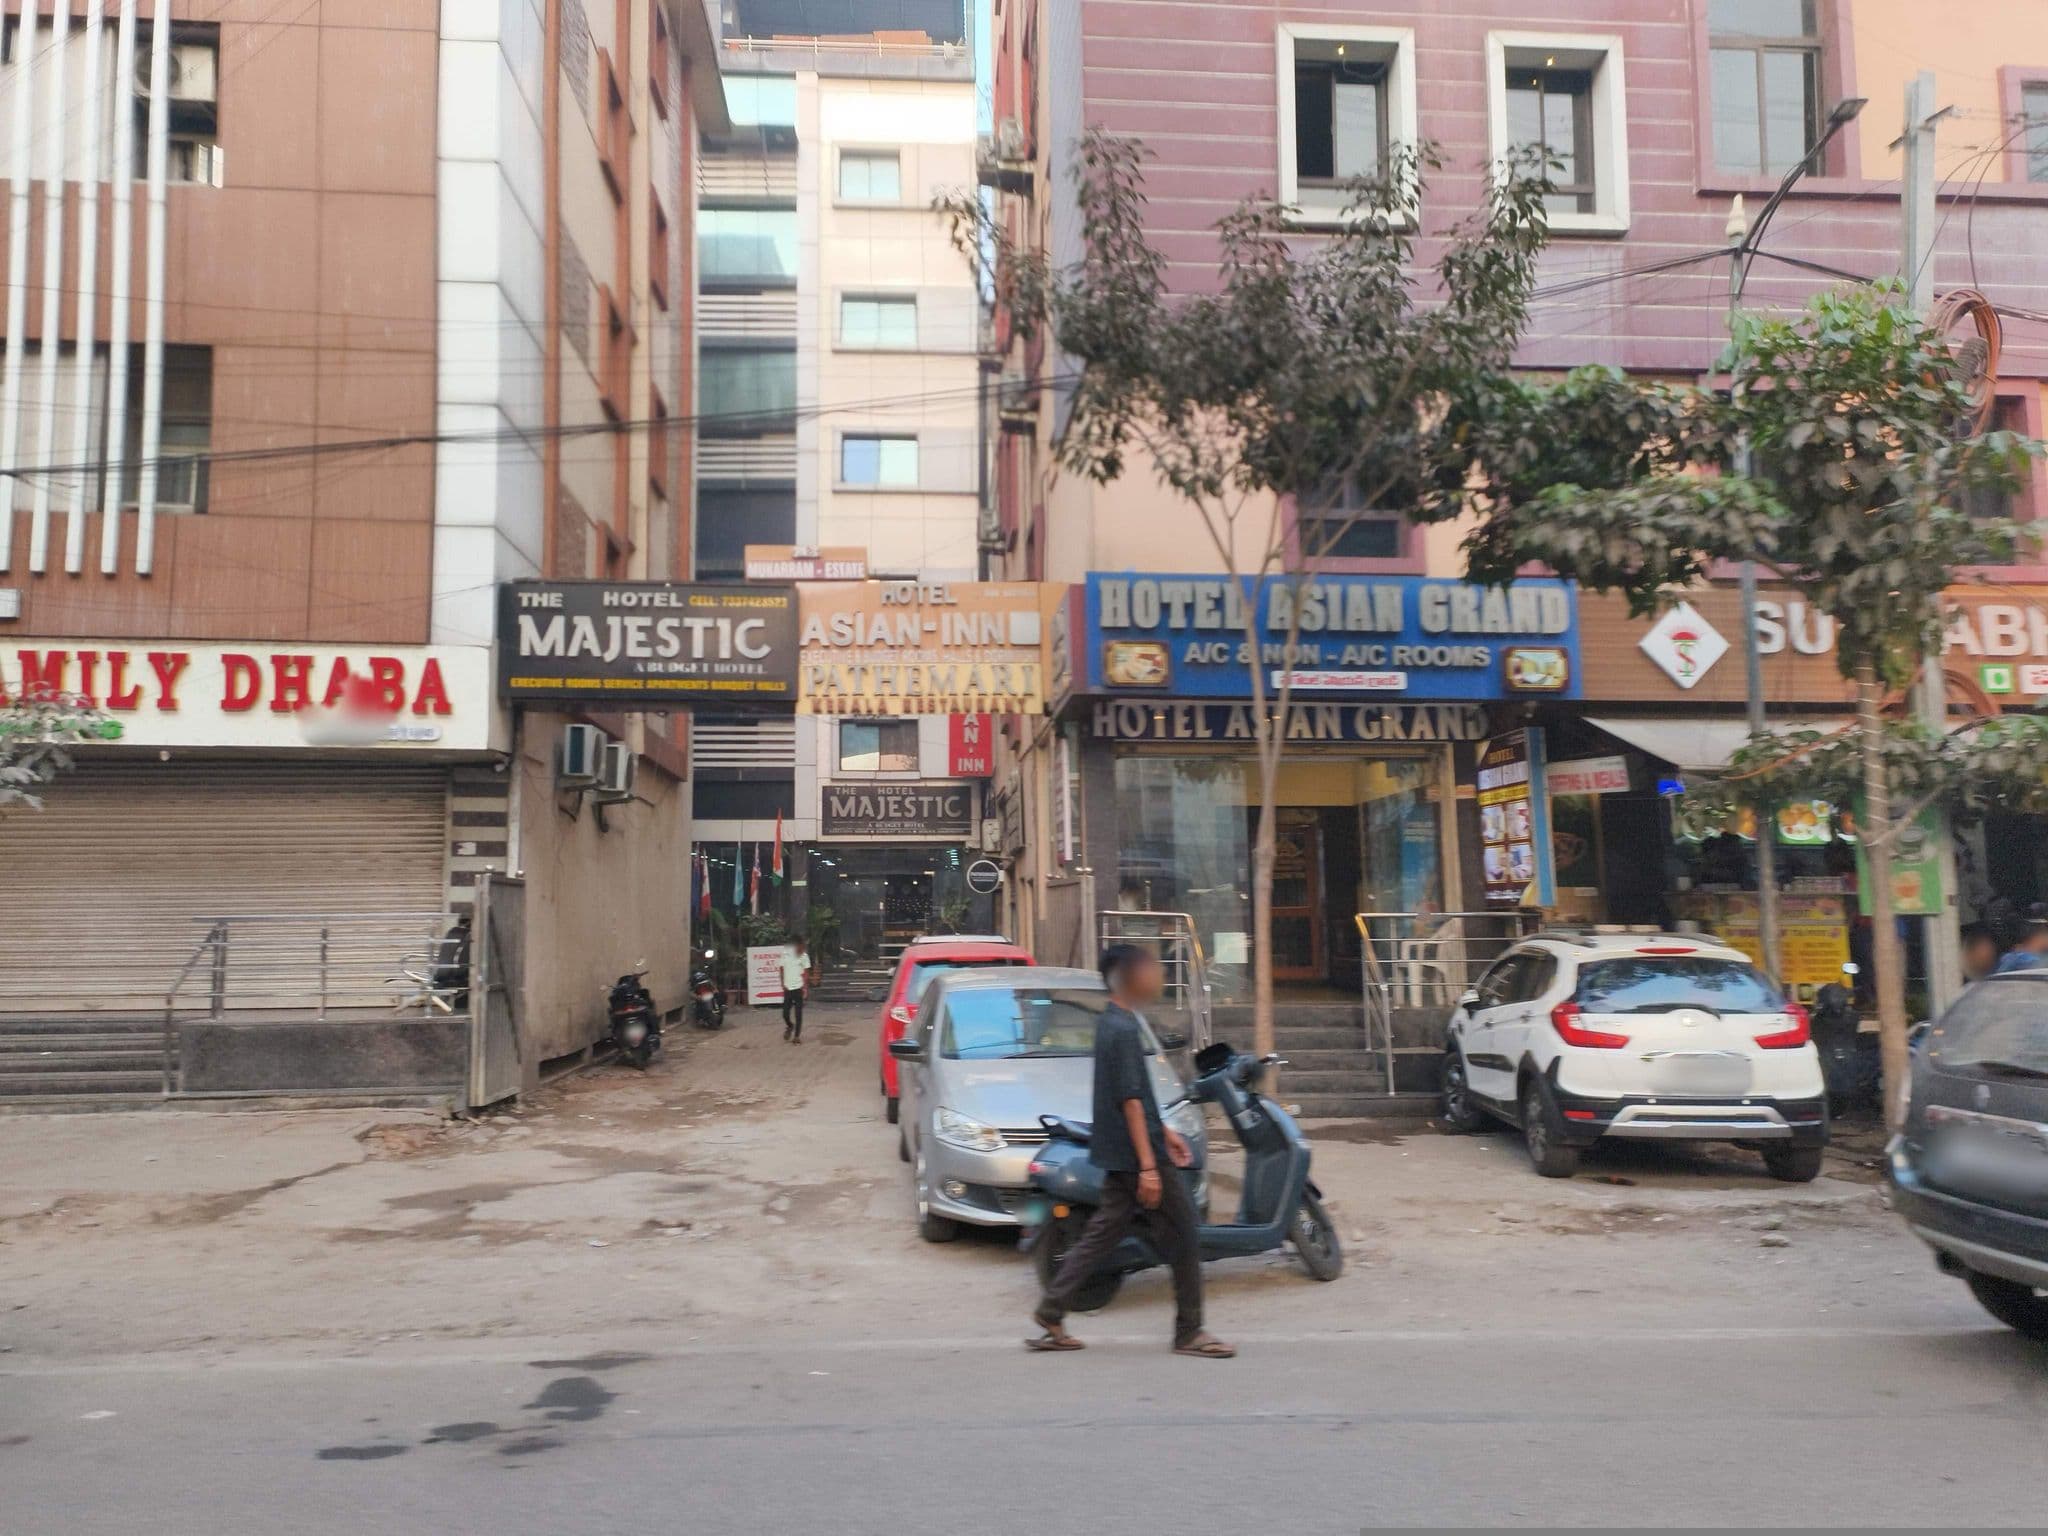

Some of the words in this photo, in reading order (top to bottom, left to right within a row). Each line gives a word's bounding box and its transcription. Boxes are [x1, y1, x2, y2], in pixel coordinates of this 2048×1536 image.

[824, 561, 865, 578] ESTATE
[518, 592, 563, 607] THE
[603, 591, 683, 607] HOTEL
[882, 585, 957, 606] HOTEL
[1100, 580, 1250, 630] HOTEL
[1266, 583, 1403, 632] ASIAN
[1419, 584, 1570, 634] GRAND
[518, 614, 771, 662] MAJESTIC
[799, 611, 1004, 647] ASIAN-INN
[1184, 642, 1230, 663] A/C
[1264, 644, 1320, 665] NON
[1341, 645, 1386, 665] A/C
[1391, 645, 1492, 667] ROOMS
[635, 663, 645, 673] A
[647, 663, 709, 673] BUDGET
[714, 663, 768, 674] HOTEL
[806, 664, 1034, 696] PATHEMARI
[220, 653, 453, 716] DHABA
[1093, 701, 1213, 739] HOTEL
[1354, 703, 1490, 740] GRAND
[957, 758, 985, 772] INN
[834, 787, 857, 795] THE
[877, 787, 915, 795] HOTEL
[830, 795, 962, 820] MAJESTIC
